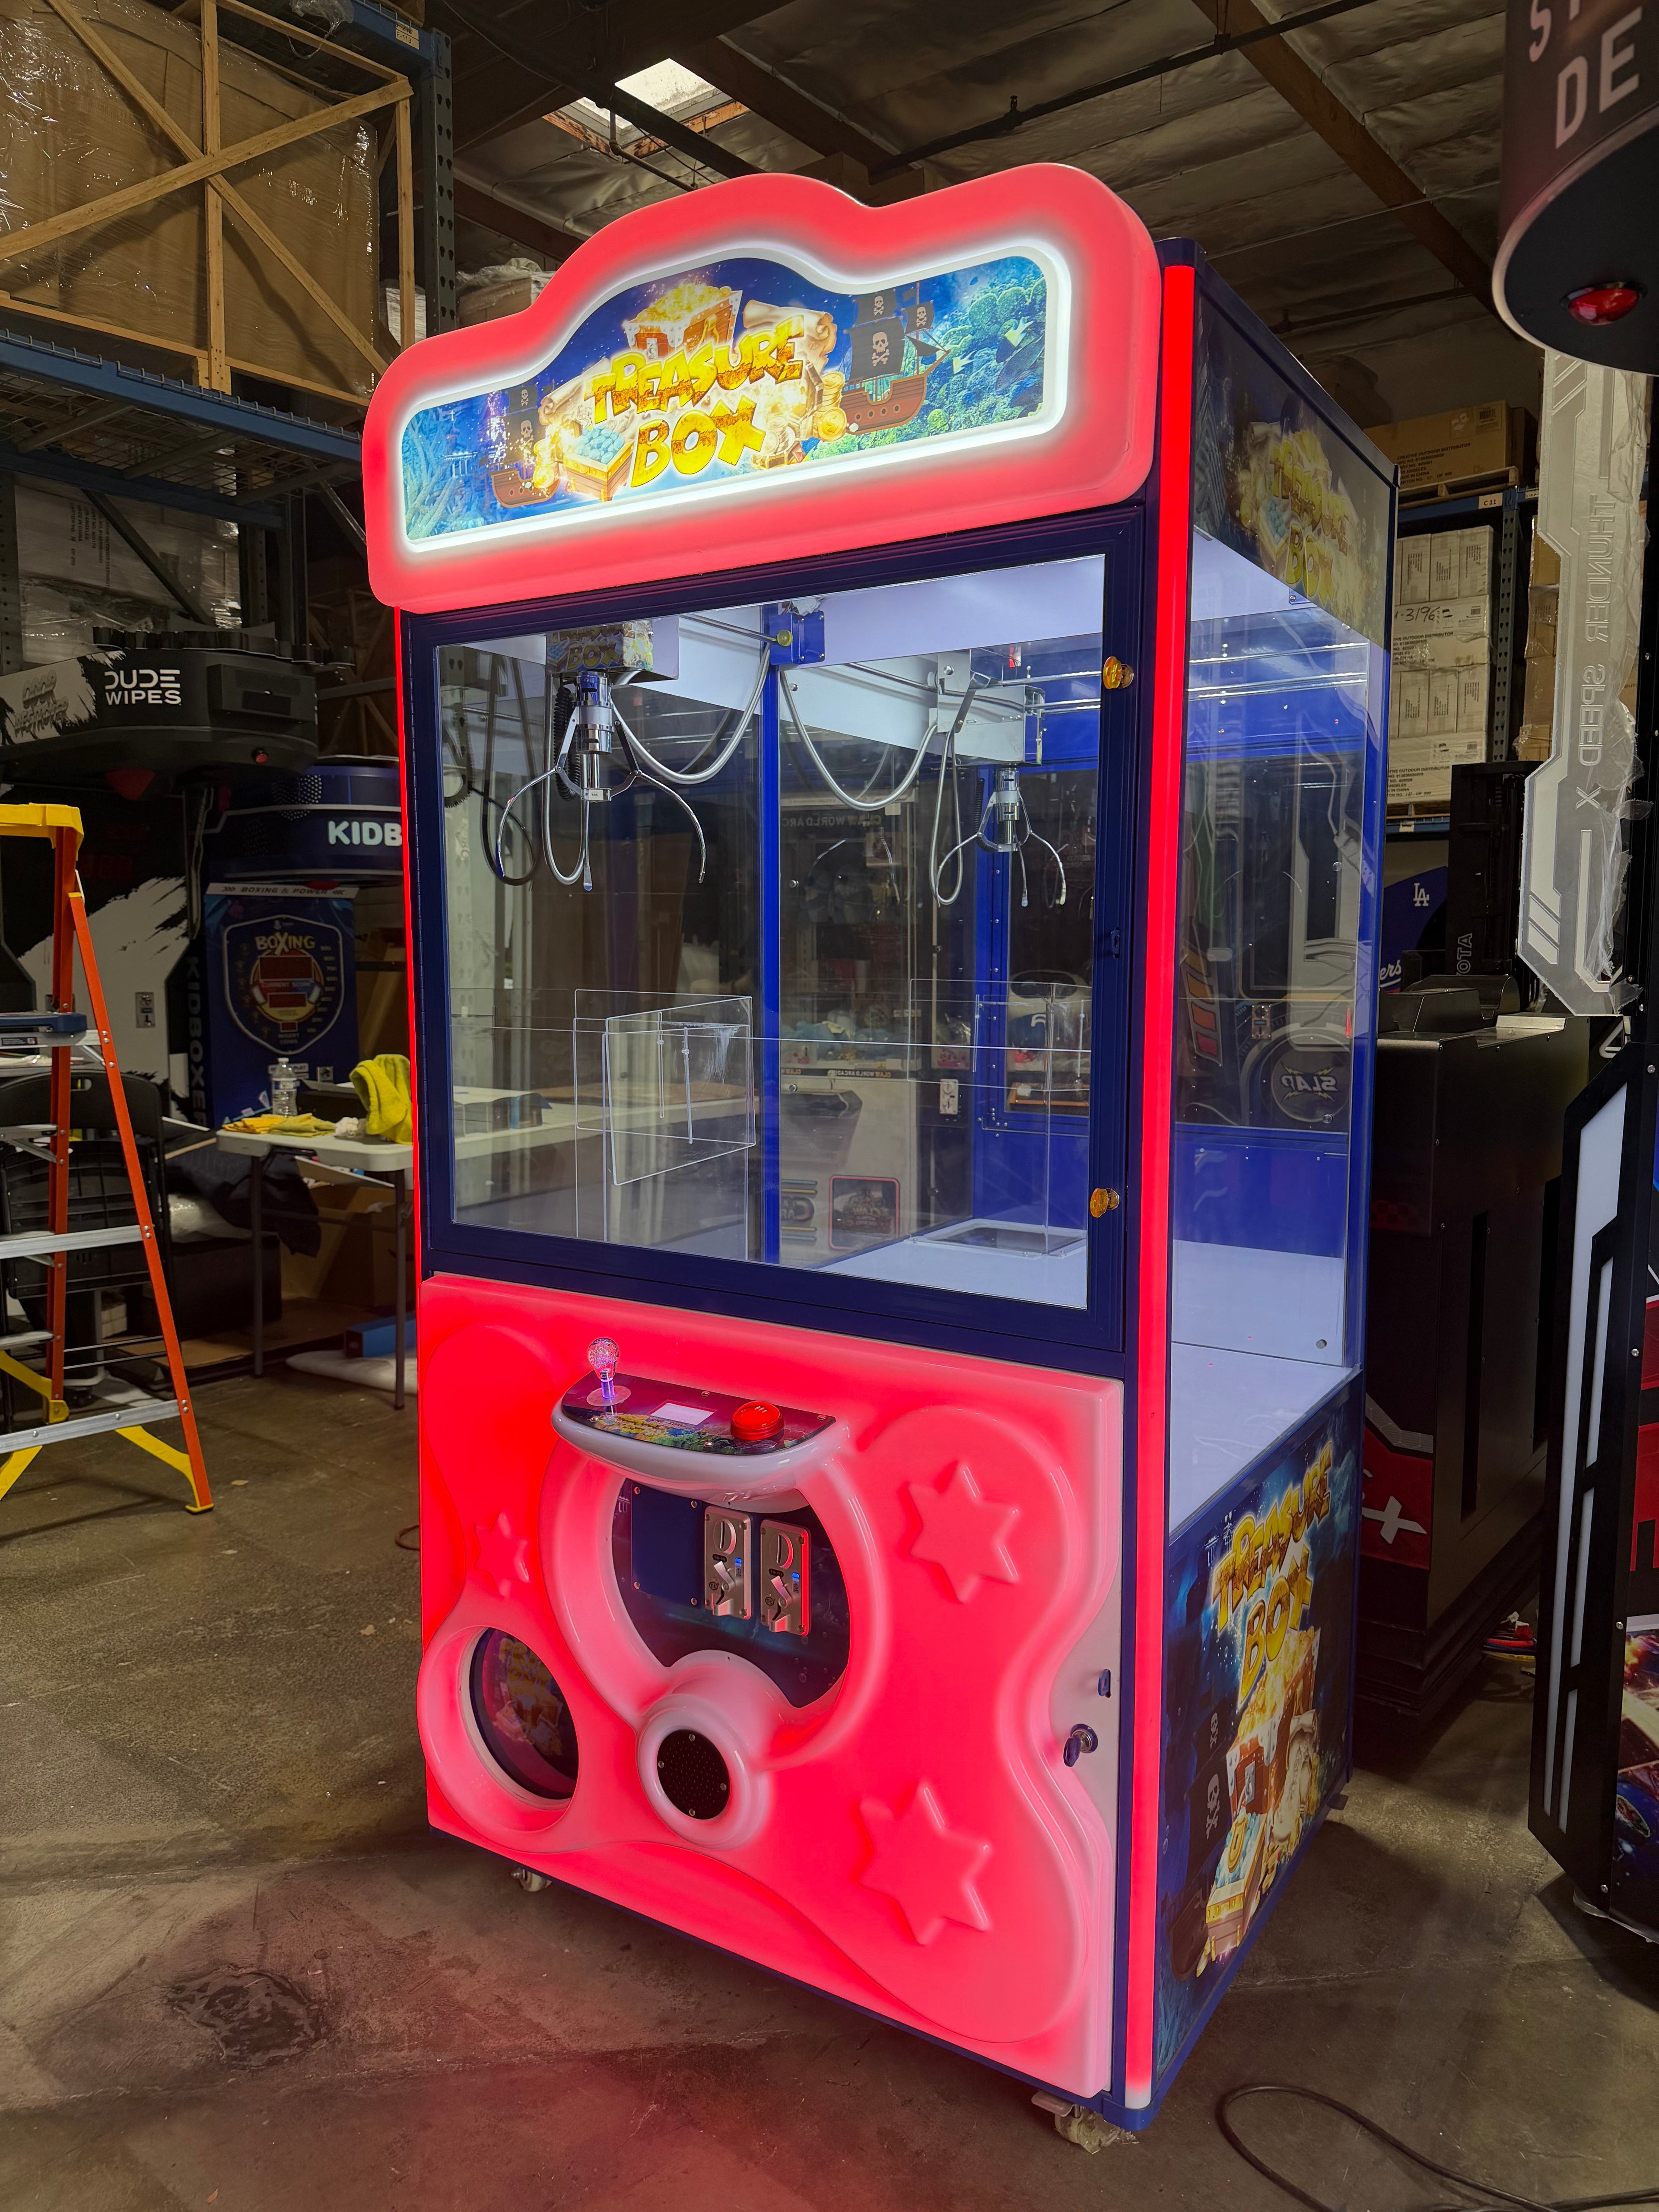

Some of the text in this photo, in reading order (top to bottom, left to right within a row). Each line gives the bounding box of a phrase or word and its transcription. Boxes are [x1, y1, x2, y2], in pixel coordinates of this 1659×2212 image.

[397, 31, 411, 43] F-113
[588, 317, 804, 424] TREASURE
[630, 395, 766, 488] BOX
[1441, 443, 1471, 452] DISTRIBUTOR
[1269, 439, 1350, 556] TREASURE
[1285, 522, 1335, 601] BOX
[567, 641, 620, 670] BOX
[104, 669, 181, 690] DUDE
[105, 689, 182, 705] WIPES
[327, 821, 404, 847] KIDB
[1413, 882, 1430, 907] LA
[254, 932, 316, 956] BOXING
[1456, 932, 1473, 976] OTA
[1379, 959, 1402, 981] ers
[1212, 1440, 1333, 1634] TREASURE
[1239, 1545, 1313, 1706] BOX
